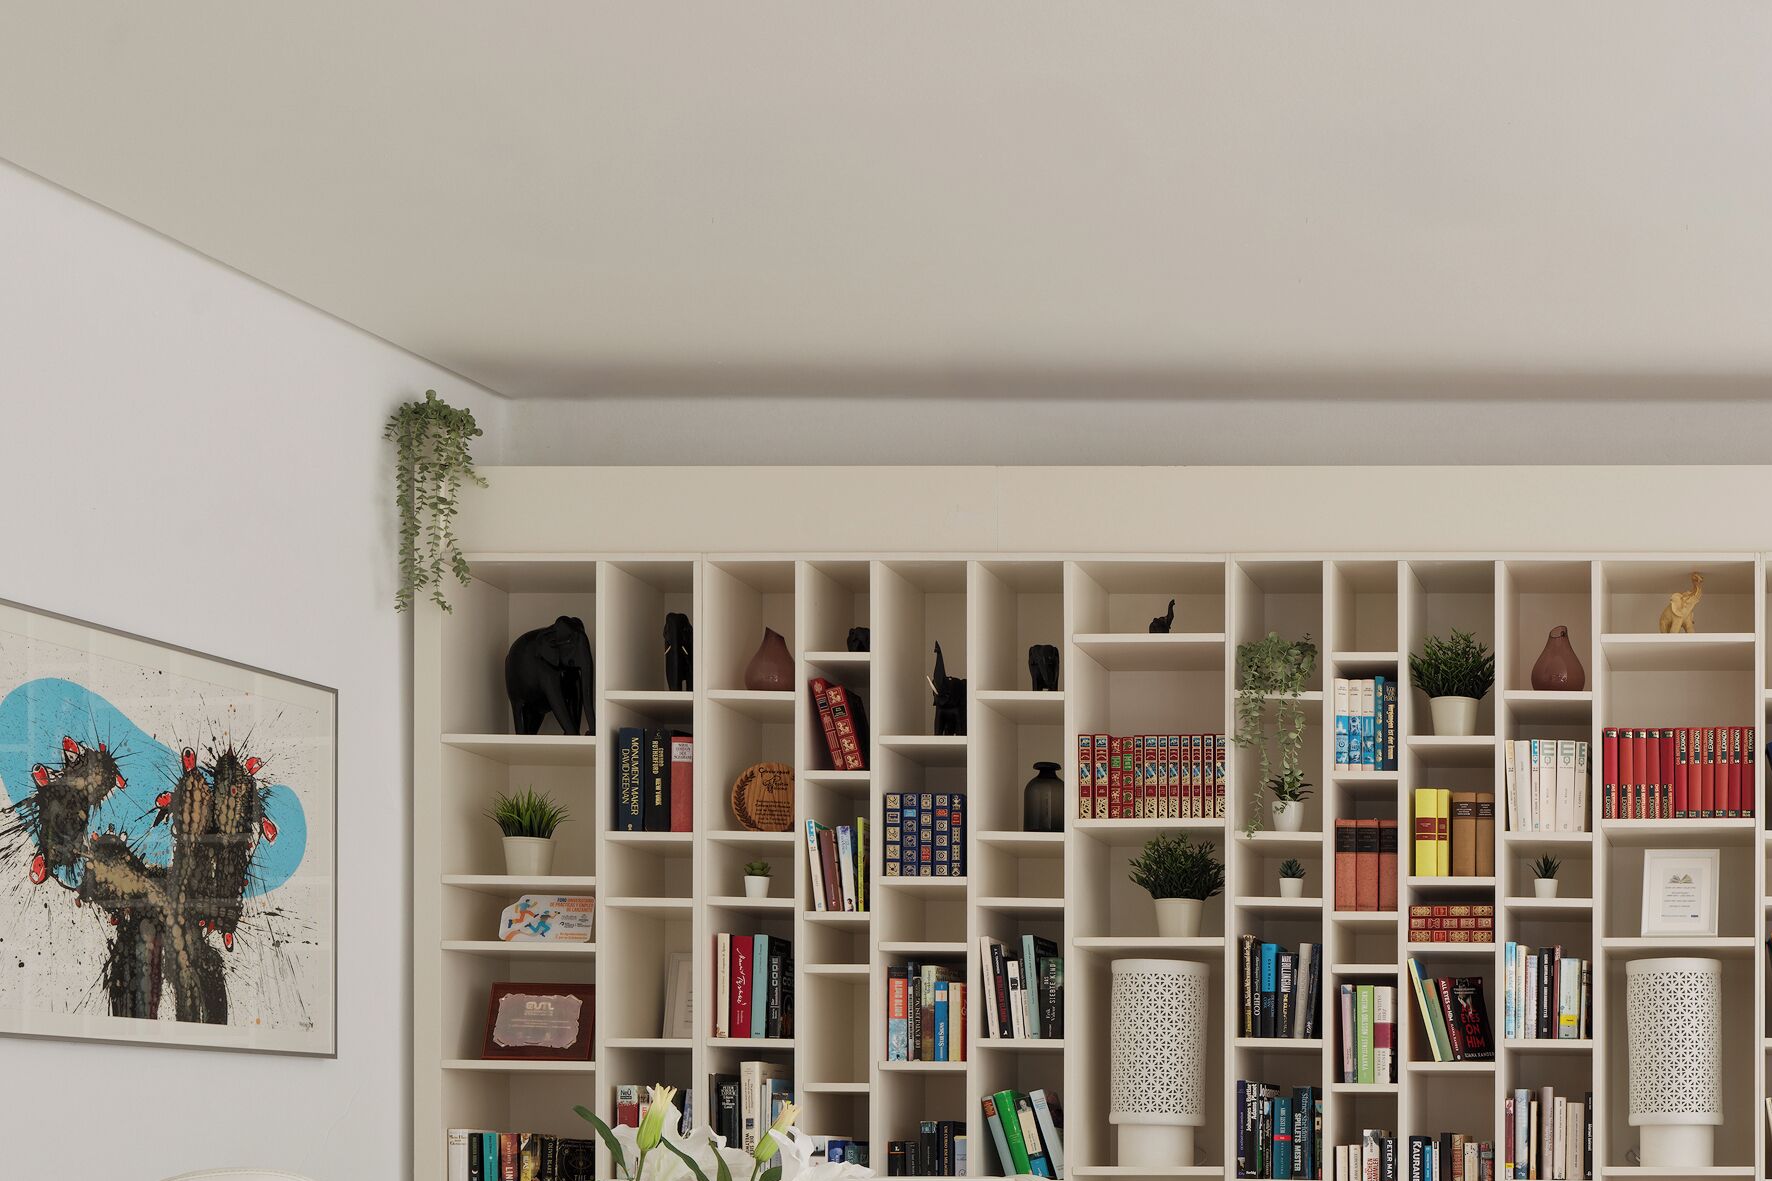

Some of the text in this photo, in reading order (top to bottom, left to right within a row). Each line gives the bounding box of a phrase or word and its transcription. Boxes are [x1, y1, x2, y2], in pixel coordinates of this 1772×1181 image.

[622, 748, 630, 804] DAVID KEENAN
[630, 736, 640, 815] MONUMENT MAKER
[655, 778, 663, 790] NEW
[1281, 963, 1291, 993] BILLINGHAM
[1442, 990, 1450, 1004] EYES
[1447, 1010, 1455, 1022] HIM
[1466, 1036, 1486, 1048] HIM
[1294, 1113, 1302, 1171] SPILLETS MESTER
